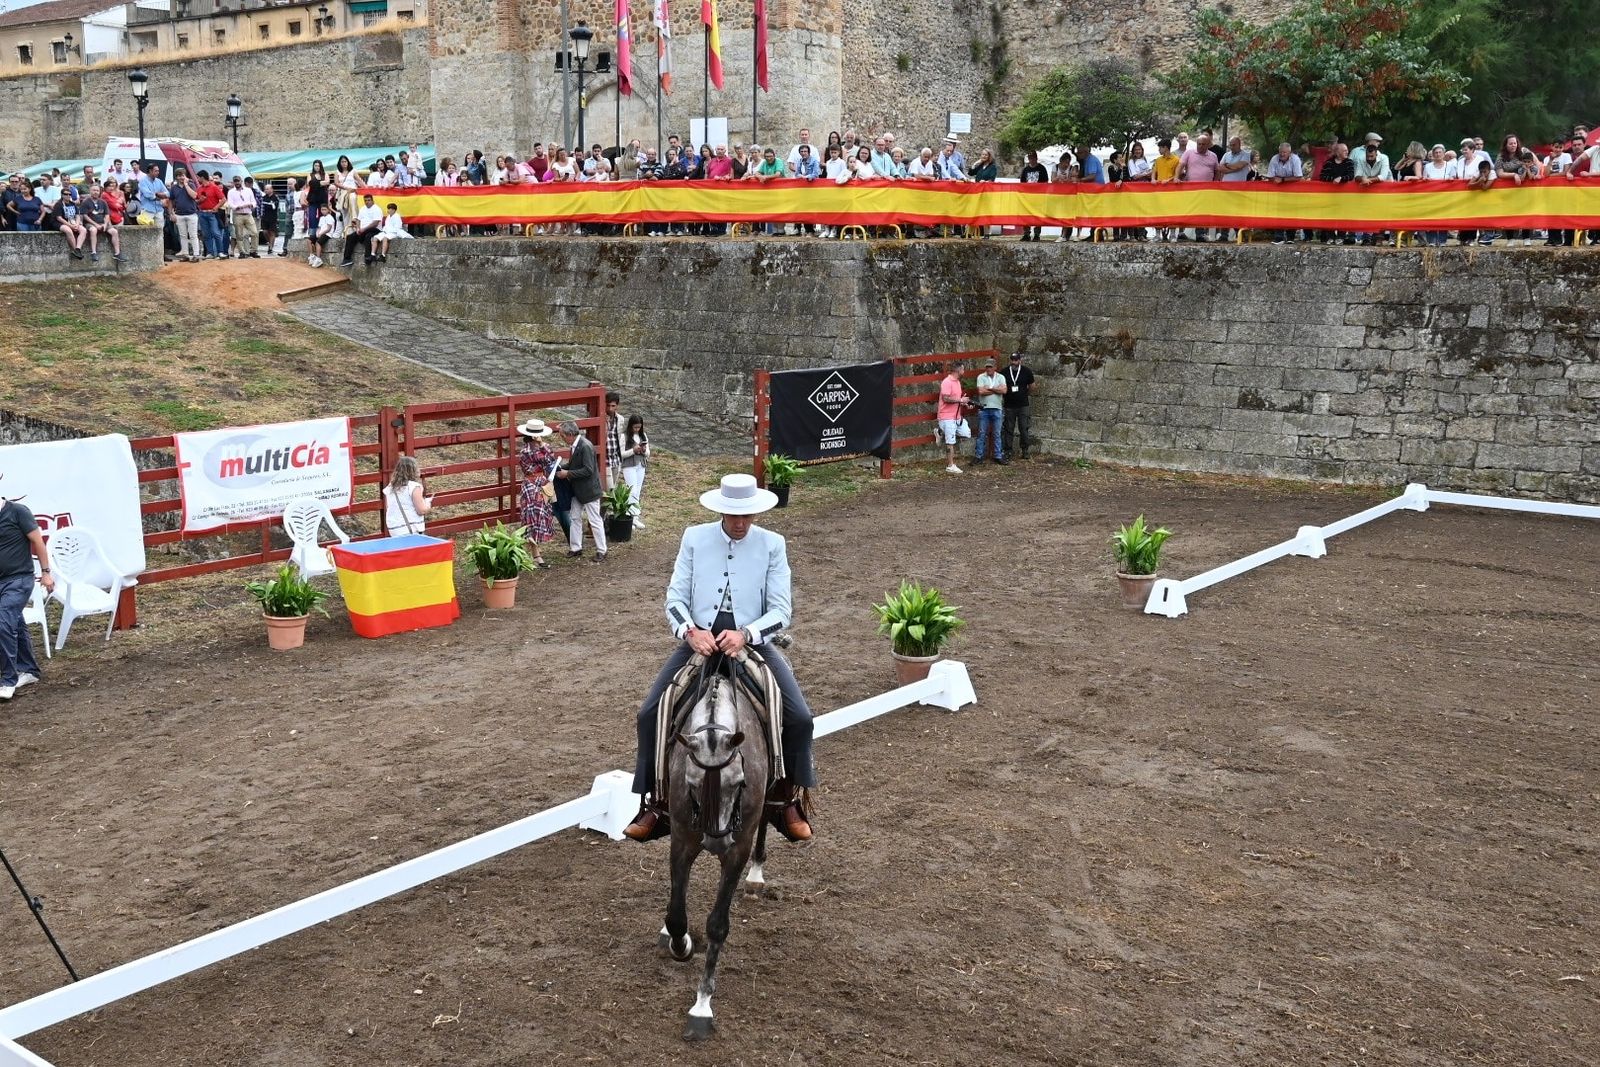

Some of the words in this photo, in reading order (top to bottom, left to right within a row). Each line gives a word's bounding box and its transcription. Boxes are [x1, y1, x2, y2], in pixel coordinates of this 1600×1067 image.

[816, 390, 850, 403] CARPISA
[822, 427, 844, 436] CIUDAD
[820, 440, 846, 450] RODRIGO
[219, 440, 330, 478] multiCía
